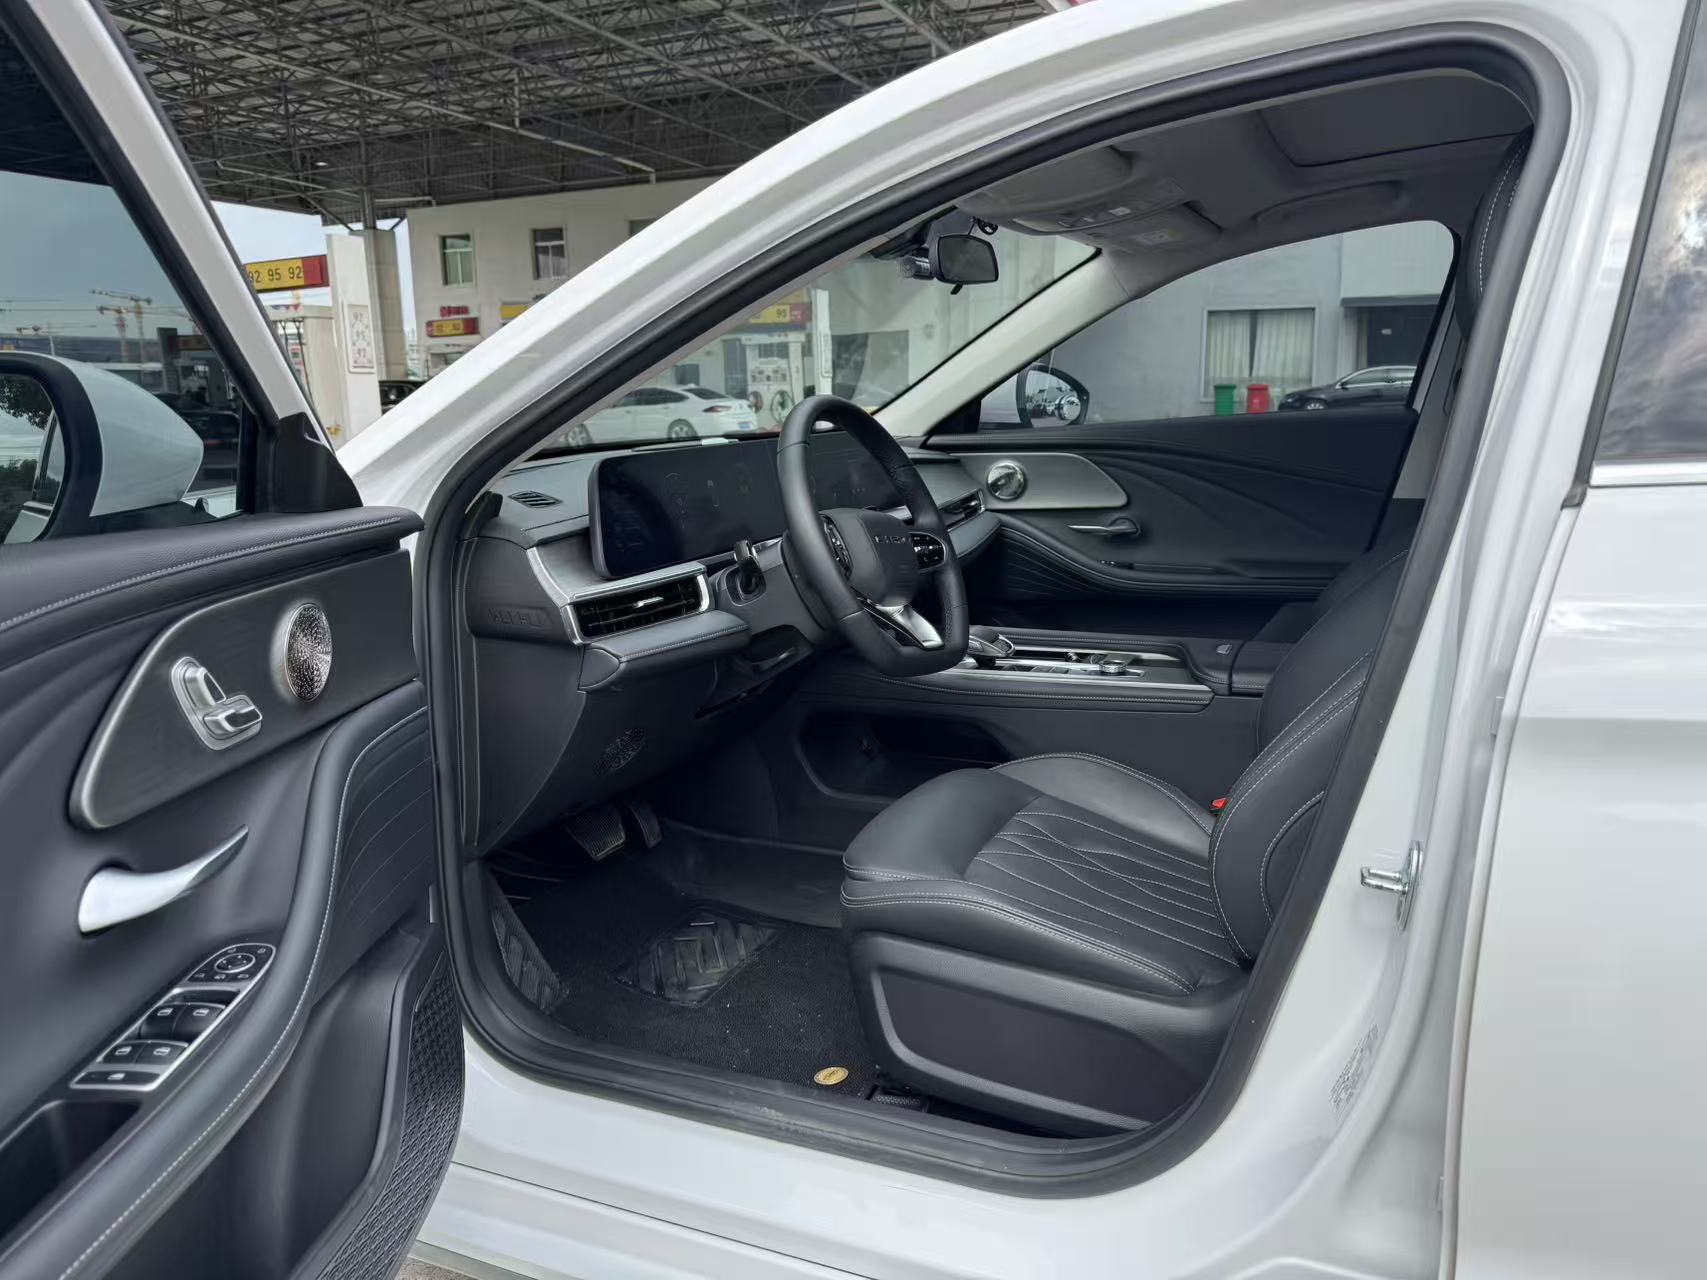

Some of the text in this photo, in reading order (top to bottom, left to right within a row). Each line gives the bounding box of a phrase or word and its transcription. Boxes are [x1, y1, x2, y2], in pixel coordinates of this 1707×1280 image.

[248, 265, 302, 283] 92 95 92
